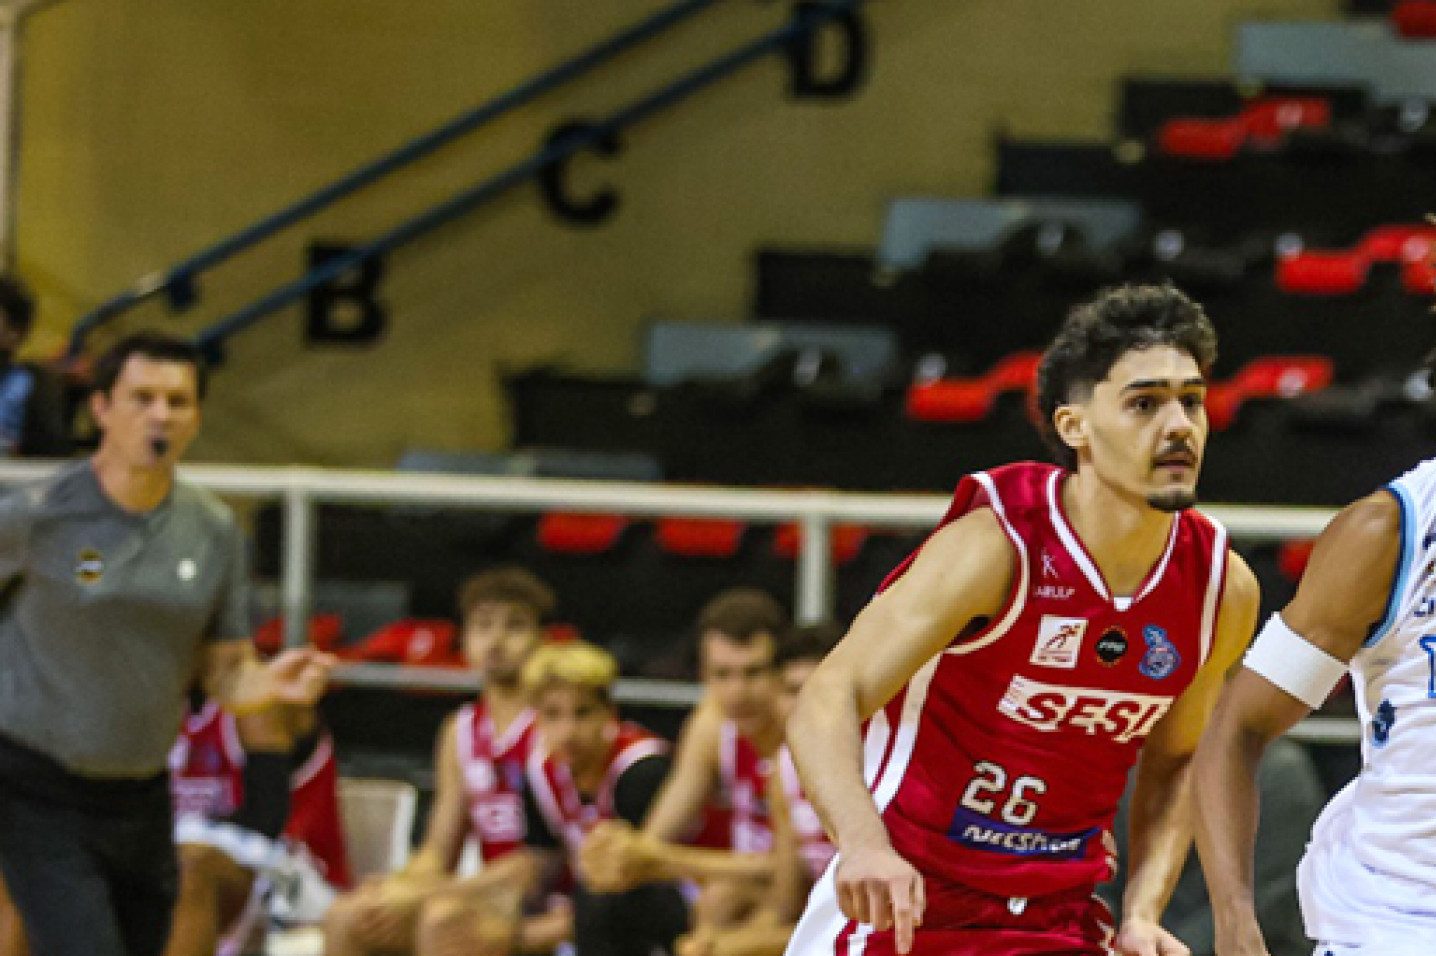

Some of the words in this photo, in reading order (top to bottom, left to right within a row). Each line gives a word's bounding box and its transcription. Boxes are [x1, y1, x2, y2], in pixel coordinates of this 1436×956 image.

[786, 0, 868, 98] D
[537, 119, 622, 227] C
[306, 242, 388, 344] B
[960, 759, 1047, 826] 26
